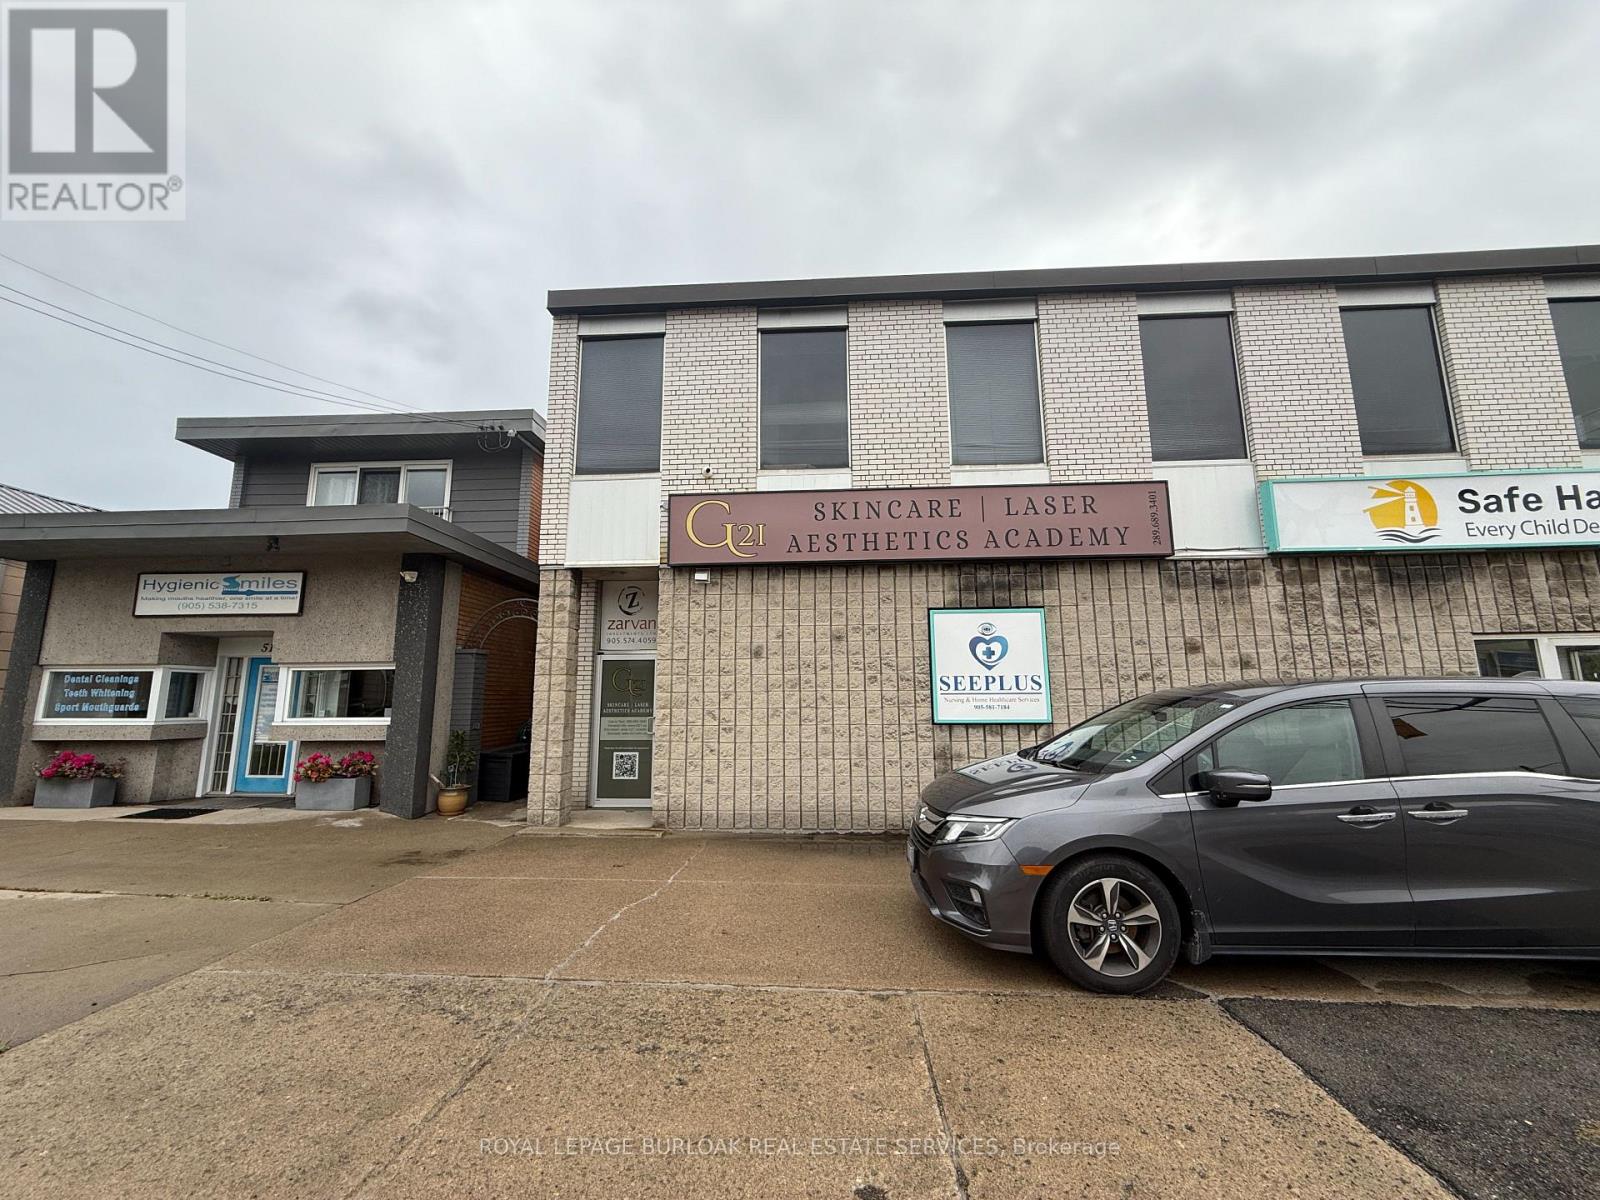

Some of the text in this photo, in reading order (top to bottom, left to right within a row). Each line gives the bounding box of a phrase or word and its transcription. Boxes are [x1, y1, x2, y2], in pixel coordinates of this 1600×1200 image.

[1457, 484, 1600, 514] Safe Ha
[814, 498, 962, 522] SKINCARE
[1004, 495, 1099, 517] LASER
[1147, 490, 1162, 545] 289.689.3401
[1465, 521, 1516, 540] Every
[1520, 518, 1570, 536] Child
[786, 526, 1130, 554] AESTHETICS ACADEMY
[143, 574, 298, 593] Hygienic Smiles
[177, 601, 258, 611] (905) 538-7315
[607, 619, 657, 630] zarvan
[64, 674, 140, 685] Dental Cleanings
[939, 674, 1043, 692] SEEPLUS
[64, 688, 136, 699] Teeth Whitening
[989, 695, 1017, 703] Healthcare
[1018, 695, 1040, 703] Services
[54, 702, 140, 713] Sport Mouthguards
